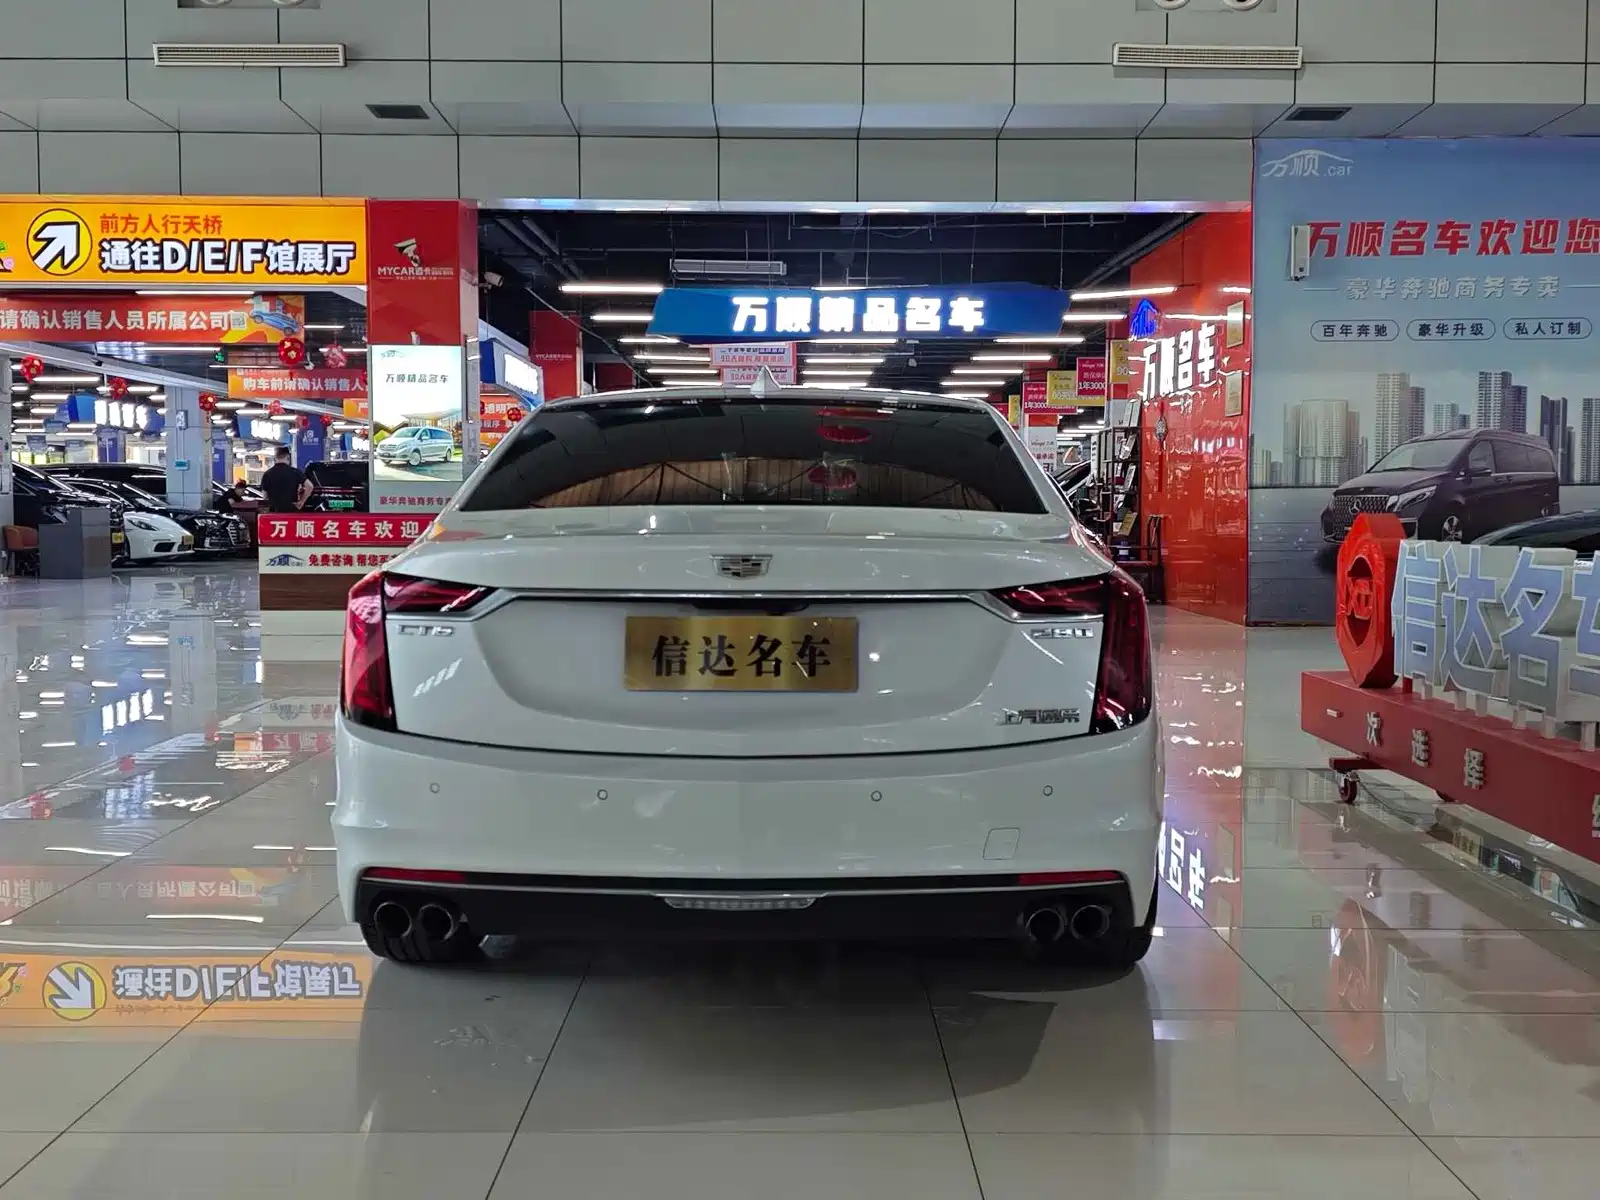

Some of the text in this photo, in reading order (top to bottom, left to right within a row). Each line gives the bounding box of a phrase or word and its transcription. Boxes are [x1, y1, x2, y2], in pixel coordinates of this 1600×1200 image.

[100, 214, 222, 235] 前方人行天桥
[1307, 219, 1600, 257] 万顺名车欢迎您
[101, 239, 356, 274] 通往D/E/F馆展厅
[1346, 276, 1560, 300] 豪华奔驰商务专卖
[732, 296, 985, 332] 万顺精品名车
[1323, 323, 1388, 337] 百年奔驰
[1418, 322, 1485, 336] 豪华升级
[1515, 321, 1581, 335] 私人订制
[385, 373, 449, 384] 万顺精品名车
[308, 554, 354, 567] 免费咨询
[651, 634, 831, 677] 信达名车
